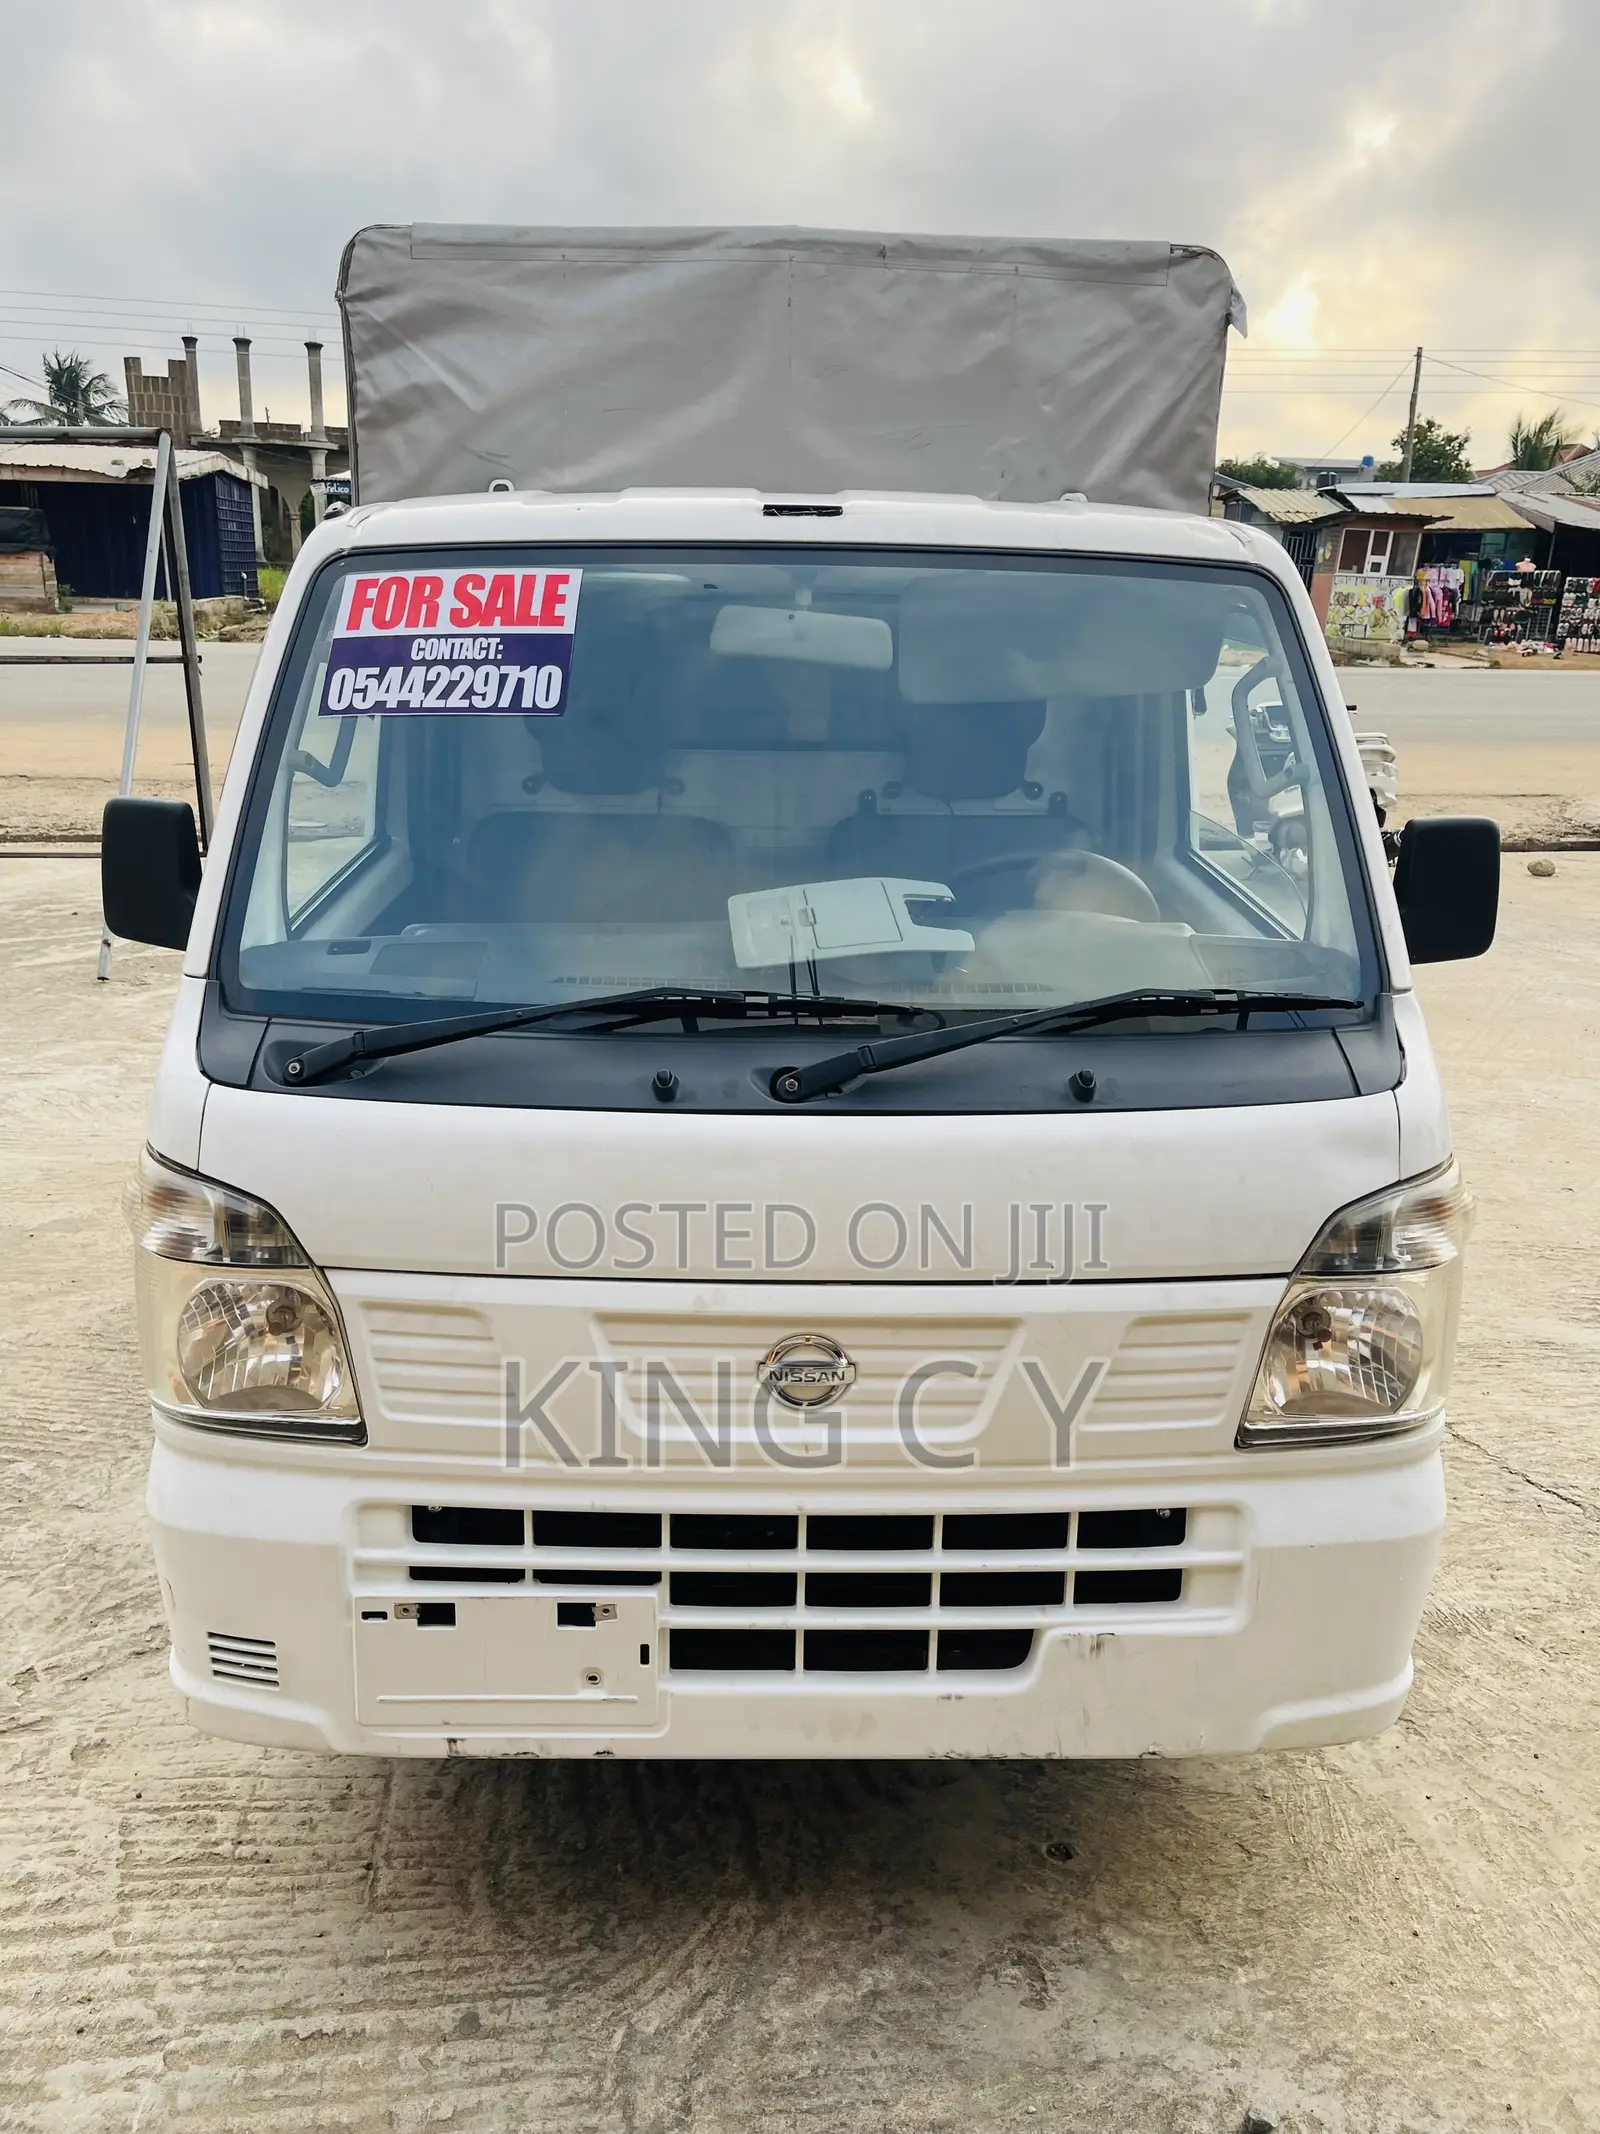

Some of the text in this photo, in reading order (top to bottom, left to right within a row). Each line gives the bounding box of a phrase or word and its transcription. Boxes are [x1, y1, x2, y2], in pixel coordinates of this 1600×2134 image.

[346, 573, 570, 631] FOR SALE
[410, 637, 504, 661] CONTACT:
[327, 665, 563, 711] 0544229710
[769, 1369, 845, 1382] NISSAN
